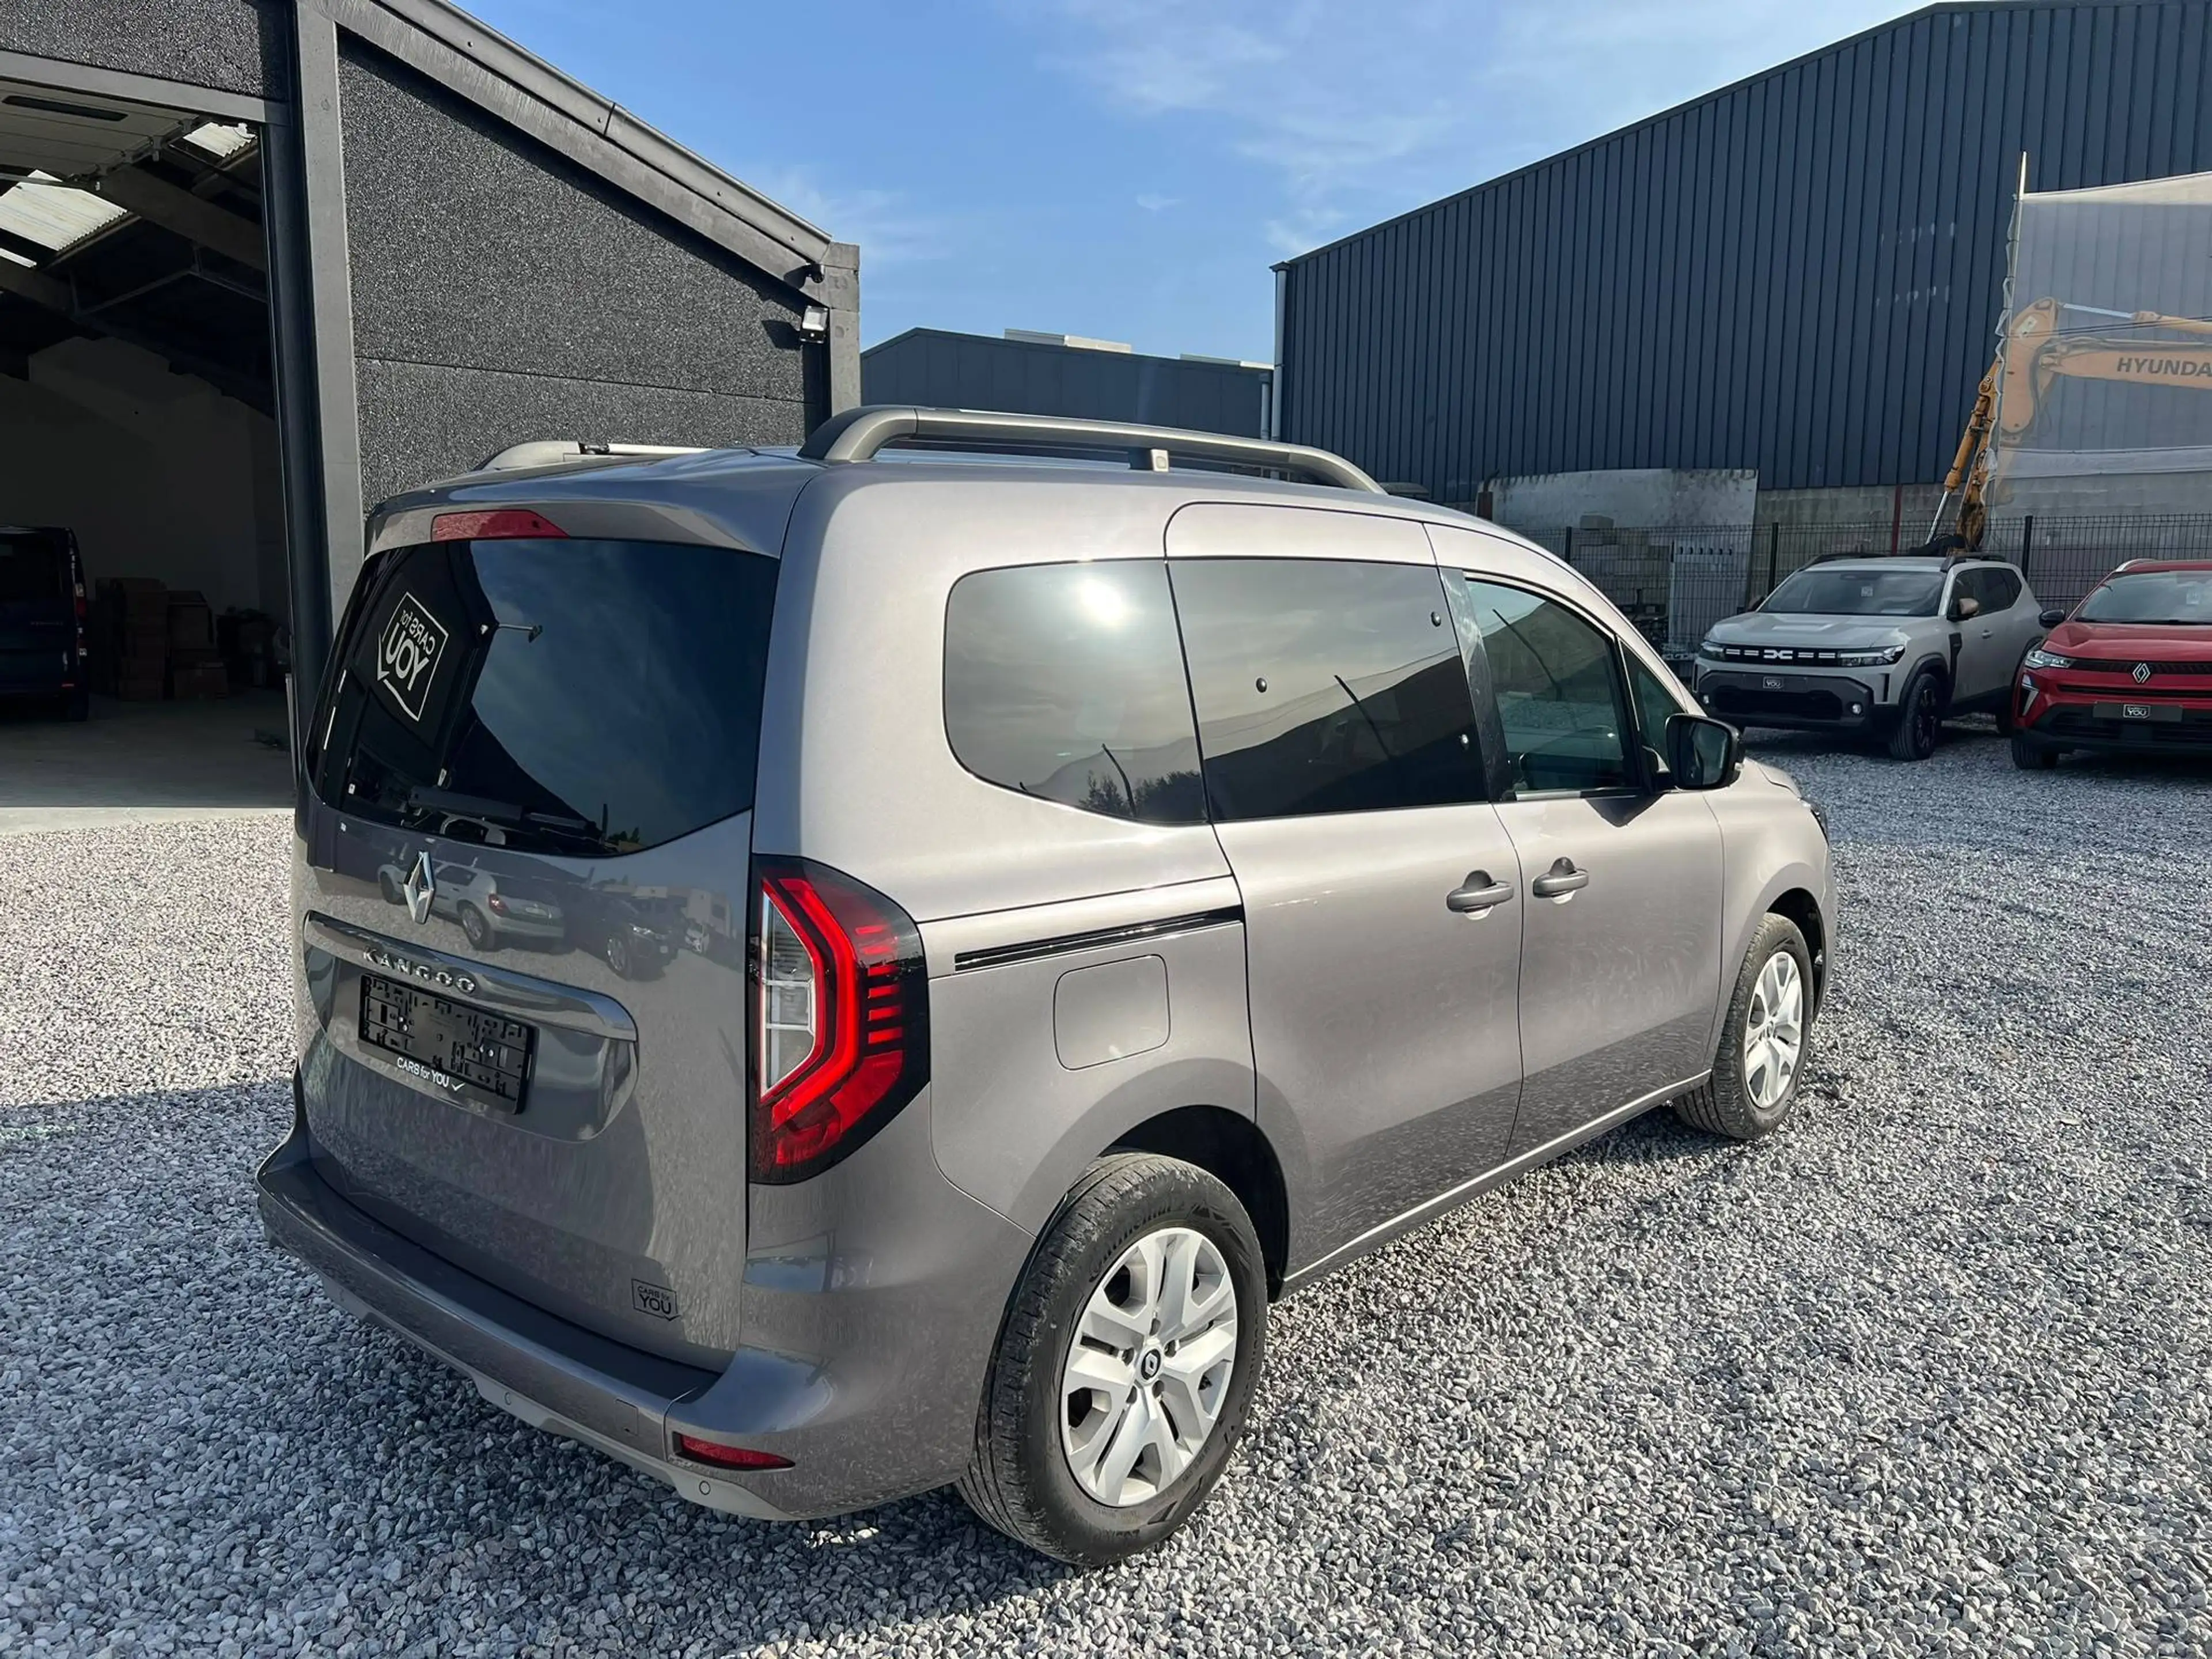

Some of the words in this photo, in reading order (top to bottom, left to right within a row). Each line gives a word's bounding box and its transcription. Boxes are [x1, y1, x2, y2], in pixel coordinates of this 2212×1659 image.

[363, 946, 476, 993] KANGOO
[397, 1057, 420, 1077] CARS
[421, 1067, 431, 1080] for
[431, 1070, 450, 1088] YOU
[638, 1286, 660, 1298] CARS
[639, 1294, 671, 1315] YOU
